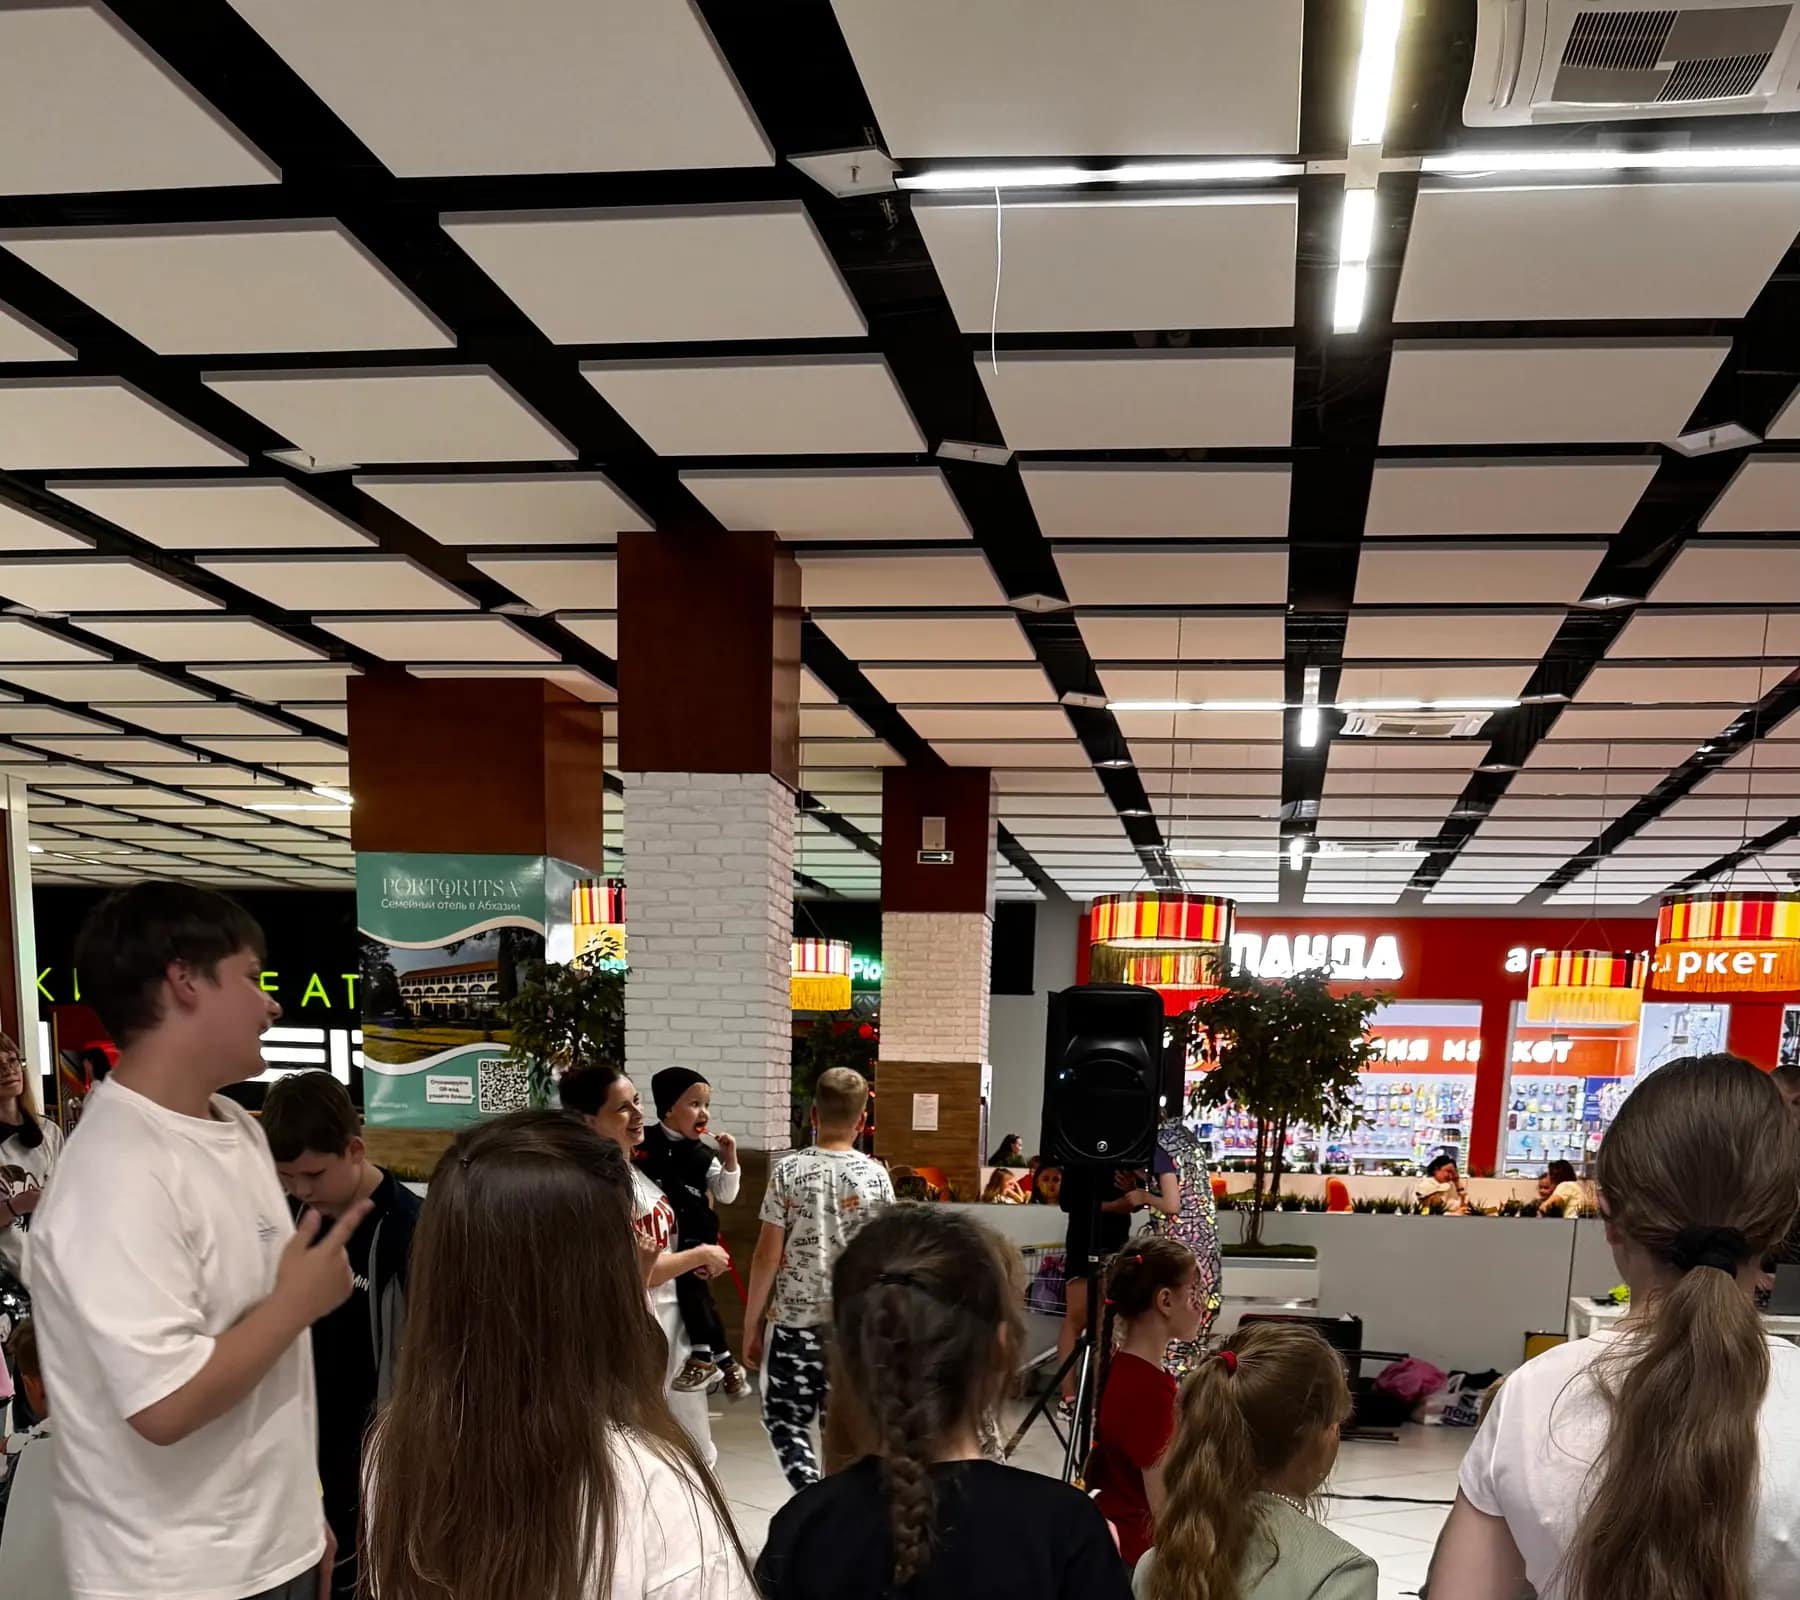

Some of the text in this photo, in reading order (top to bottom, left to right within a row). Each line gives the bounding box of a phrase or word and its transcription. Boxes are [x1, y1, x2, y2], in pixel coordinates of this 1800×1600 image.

[383, 877, 520, 898] PORTORITSA
[381, 898, 521, 911] Семейный отель в Абхазии
[1230, 932, 1404, 980] ПАНДА
[1625, 949, 1778, 983] ркет
